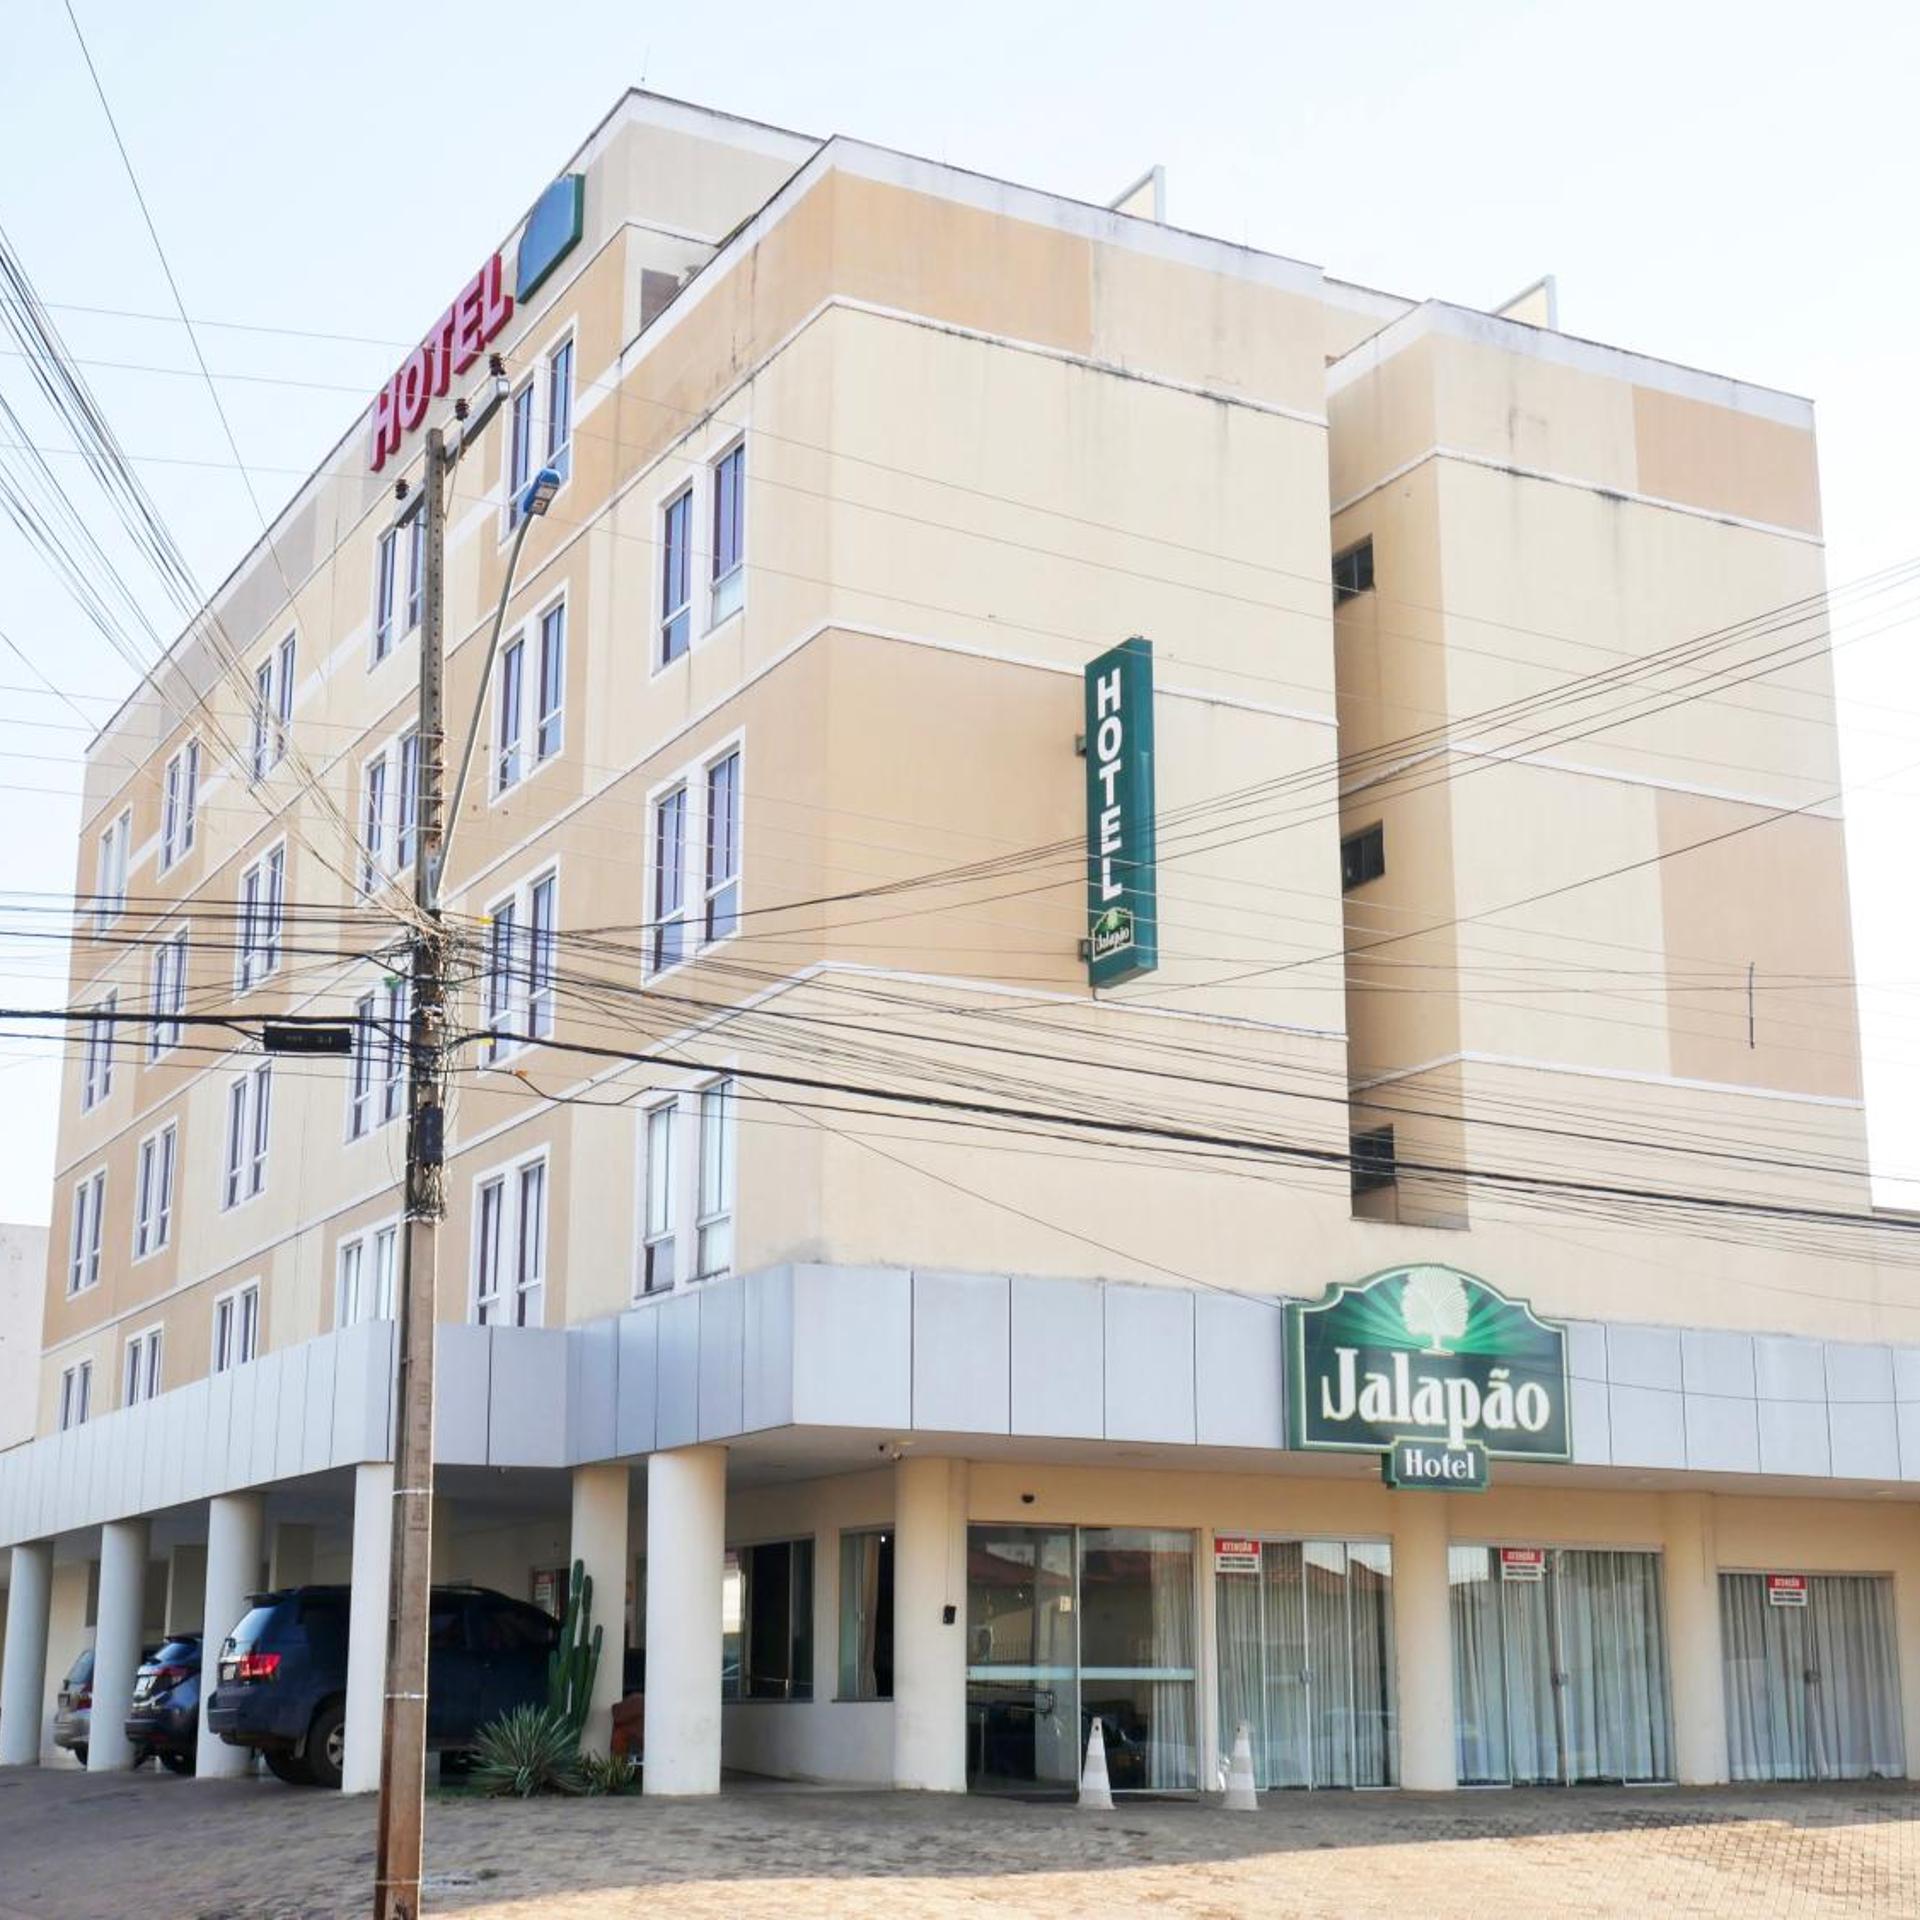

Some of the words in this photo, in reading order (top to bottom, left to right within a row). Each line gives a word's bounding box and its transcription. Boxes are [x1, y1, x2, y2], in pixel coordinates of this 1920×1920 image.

[369, 252, 514, 472] HOTEL
[1097, 667, 1123, 902] HOTEL
[1321, 1347, 1551, 1450] Jalapão
[1404, 1449, 1476, 1480] Hotel
